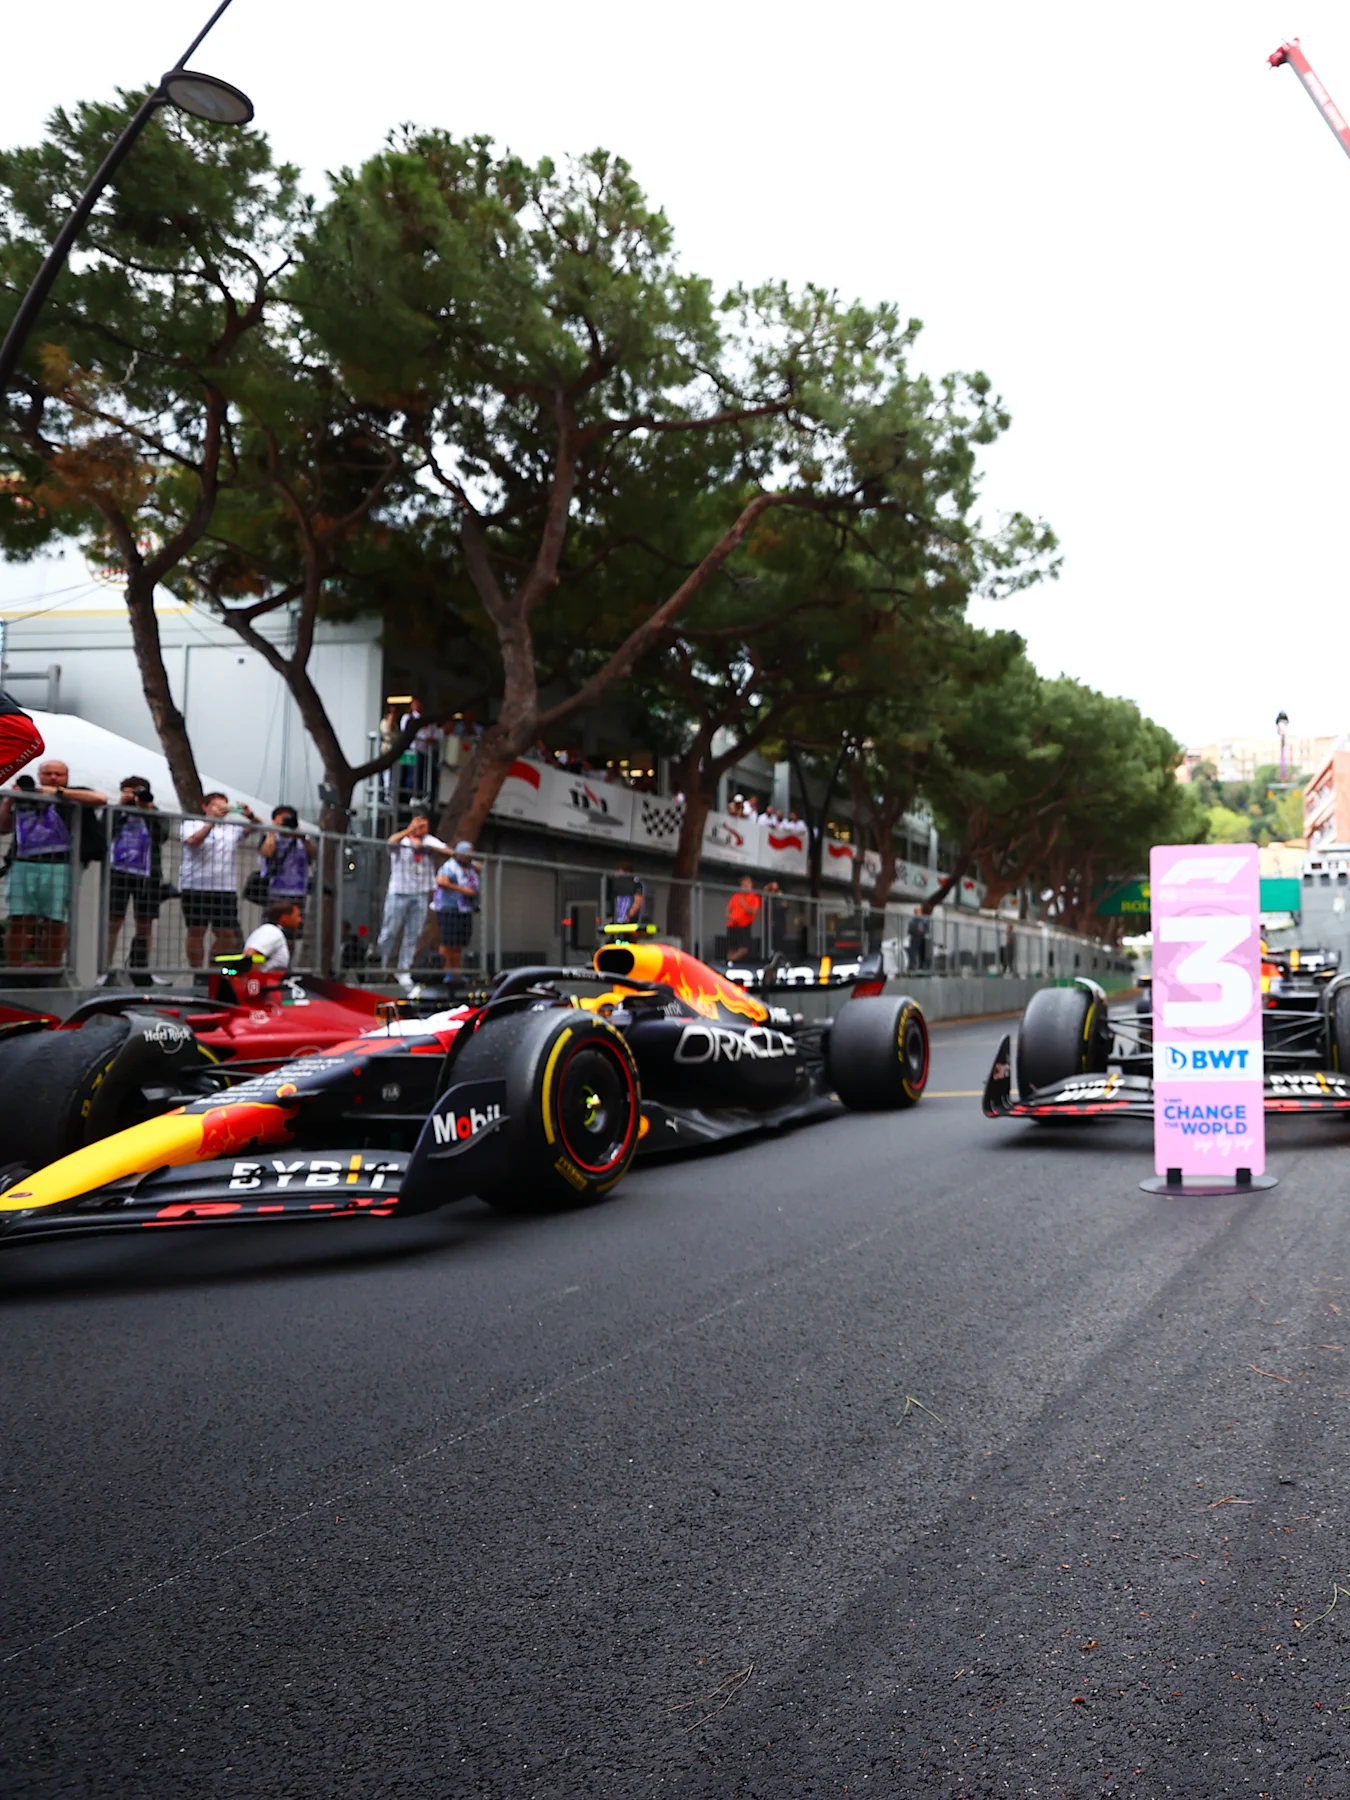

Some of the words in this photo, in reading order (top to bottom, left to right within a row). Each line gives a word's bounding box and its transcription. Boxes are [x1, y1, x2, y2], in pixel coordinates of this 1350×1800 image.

[1160, 916, 1253, 1027] 3
[674, 1025, 796, 1064] ORACLE
[1192, 1050, 1249, 1069] BWT
[432, 1104, 500, 1144] Mobil
[1164, 1105, 1247, 1119] CHANGE
[1181, 1122, 1248, 1135] WORLD
[229, 1155, 399, 1189] BYBIT
